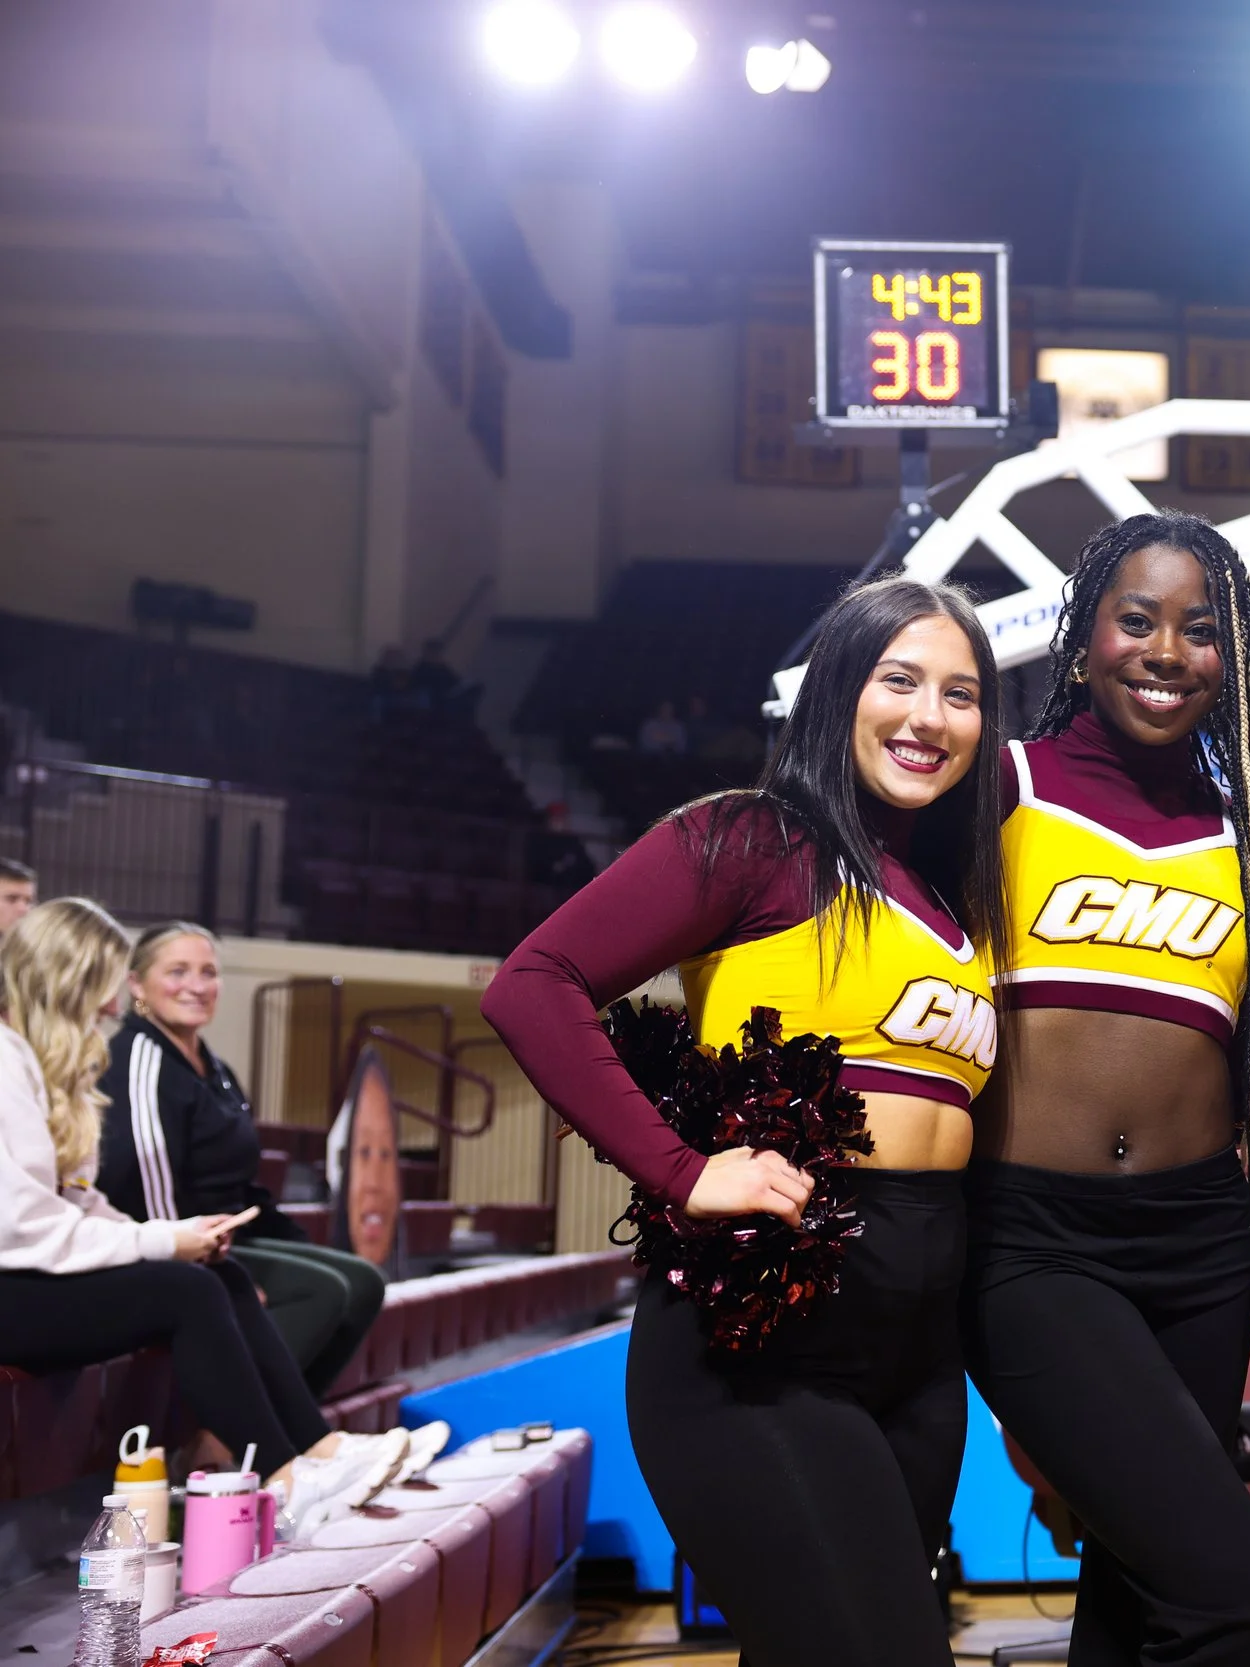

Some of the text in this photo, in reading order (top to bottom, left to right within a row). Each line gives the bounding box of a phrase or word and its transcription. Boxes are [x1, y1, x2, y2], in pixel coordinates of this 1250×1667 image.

[871, 271, 982, 325] 4:43
[870, 329, 961, 402] 30
[1028, 874, 1244, 961] CMU
